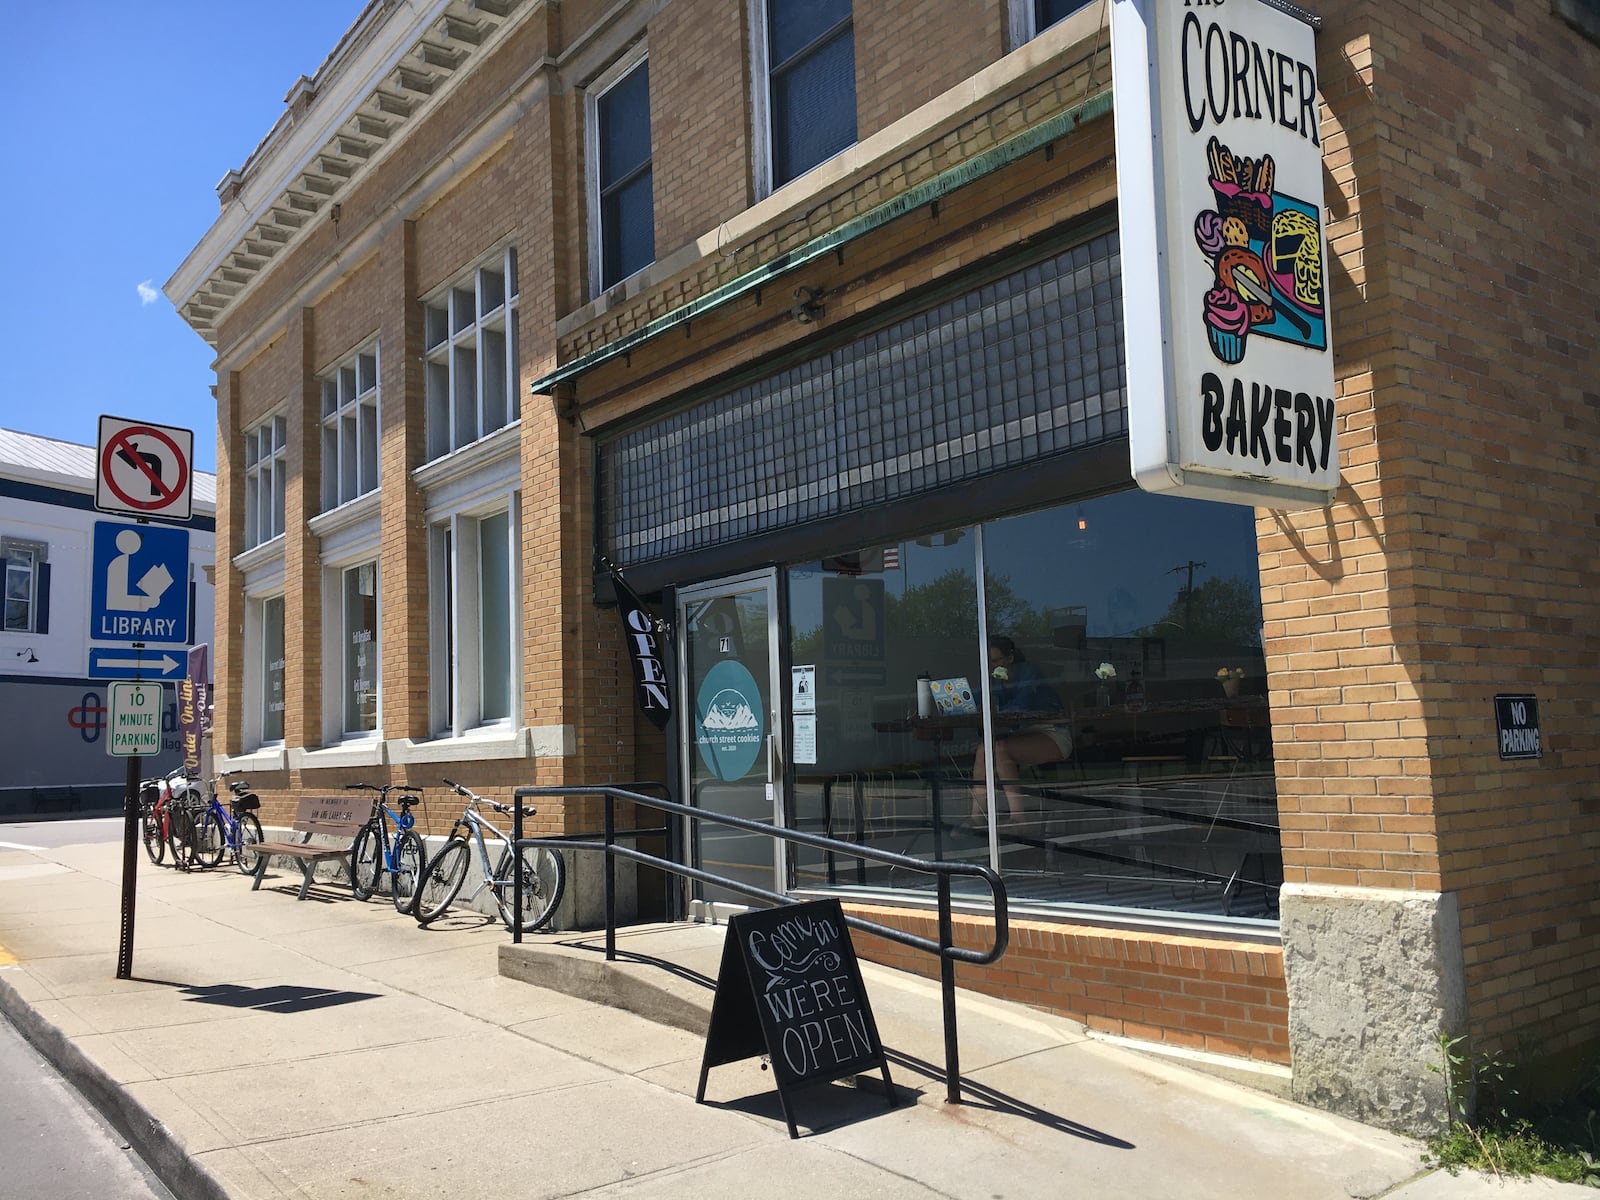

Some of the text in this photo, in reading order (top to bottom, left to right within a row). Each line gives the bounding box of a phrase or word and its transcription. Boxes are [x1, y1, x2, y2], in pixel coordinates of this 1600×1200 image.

[1181, 11, 1320, 148] CORNER
[1201, 372, 1335, 474] BAKERY
[102, 615, 176, 636] LIBRARY
[720, 638, 730, 652] 71
[628, 609, 670, 710] OPEN
[130, 693, 145, 706] 10
[120, 713, 153, 726] MINUTE
[1510, 701, 1527, 725] NO
[115, 732, 156, 746] PARKING
[183, 731, 199, 770] Order
[699, 733, 760, 744] church street cookies
[1502, 728, 1540, 752] PARKING
[749, 915, 839, 971] Come in
[783, 1009, 873, 1076] OPEN
